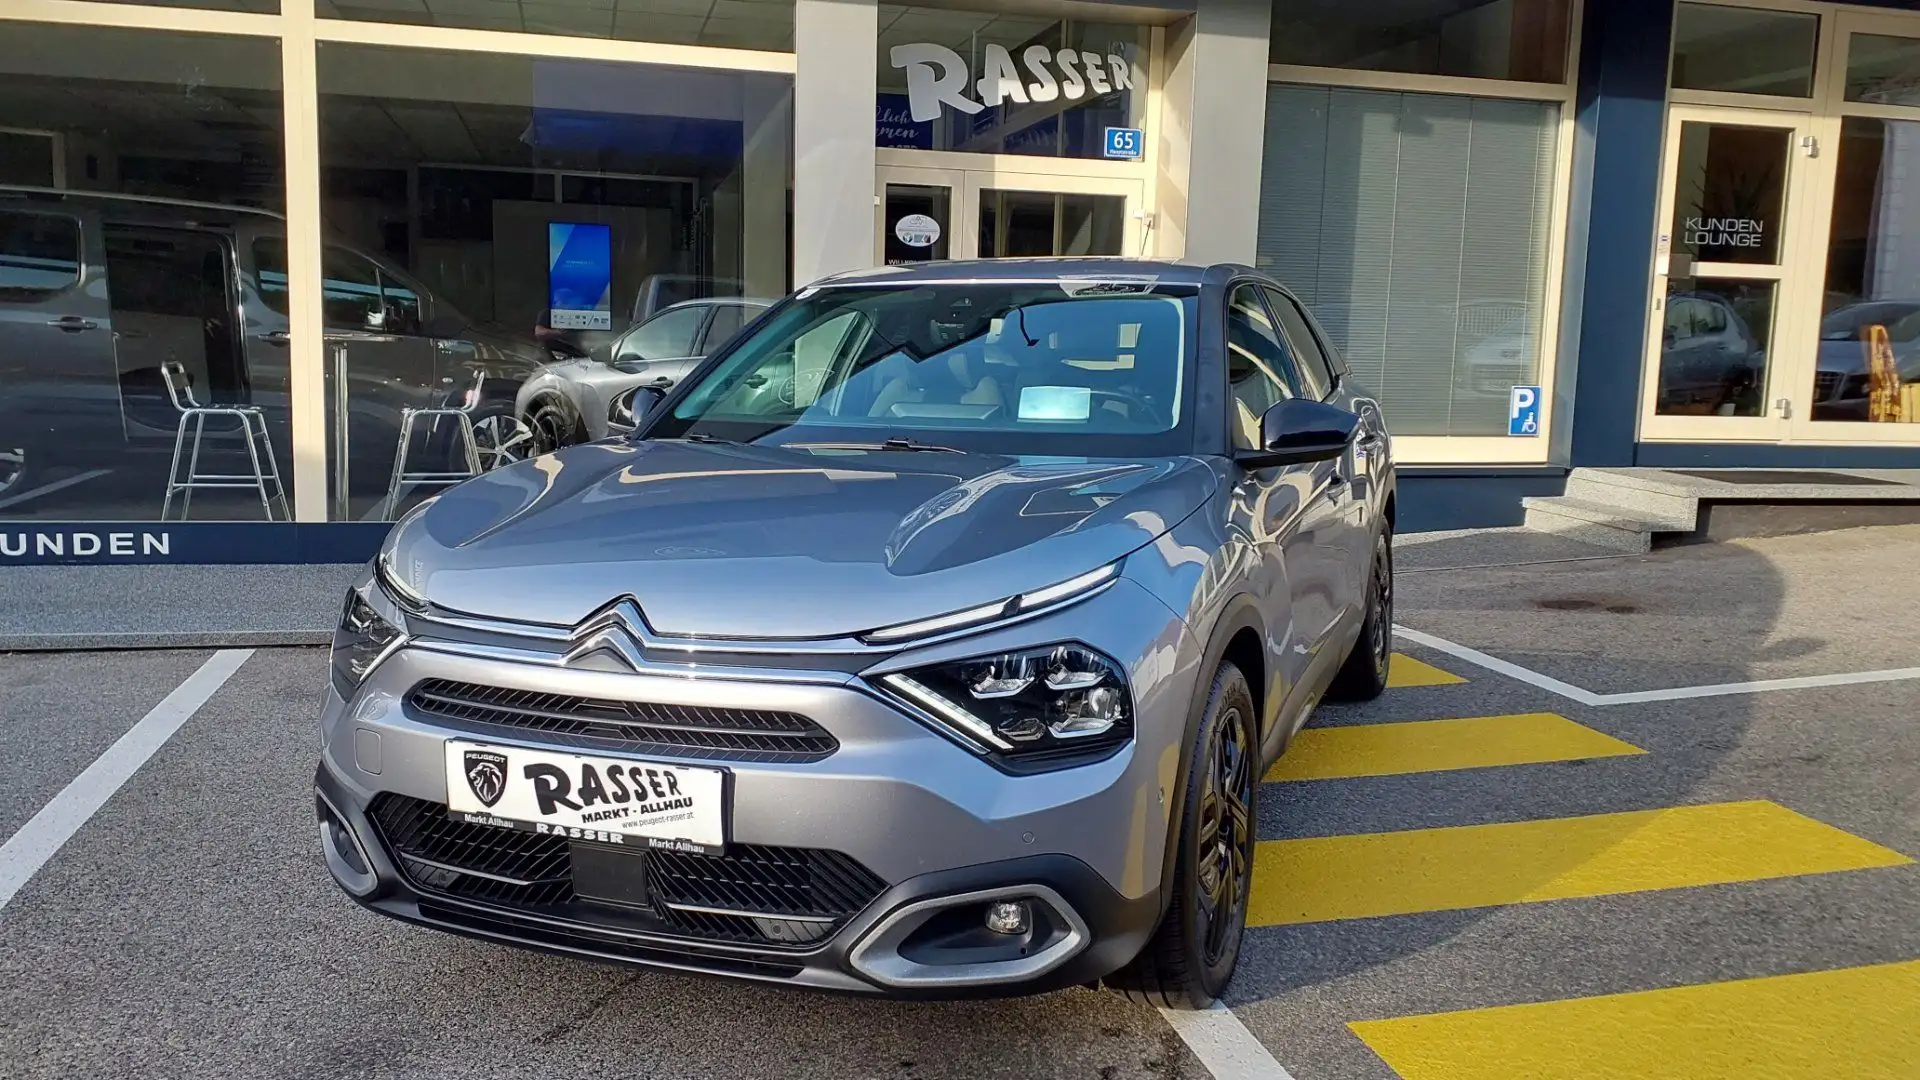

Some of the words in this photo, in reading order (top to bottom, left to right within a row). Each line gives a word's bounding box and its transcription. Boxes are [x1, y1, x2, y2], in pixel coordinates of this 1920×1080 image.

[890, 43, 1134, 123] RASSER
[1113, 132, 1134, 149] 65
[1686, 217, 1763, 232] KUNDEN
[1684, 231, 1761, 247] LOUNGE
[1512, 388, 1535, 419] P
[465, 753, 506, 763] PEUGEOT
[523, 763, 682, 815] RASSER
[582, 808, 630, 824] MARKT
[640, 797, 693, 815] ALLHAU
[464, 813, 486, 824] Markt
[487, 817, 514, 828] Allhau
[621, 812, 694, 829] www.peugeot-rasser.at
[536, 823, 624, 844] RASSER
[649, 838, 674, 850] Markt
[675, 841, 705, 853] Allhau
